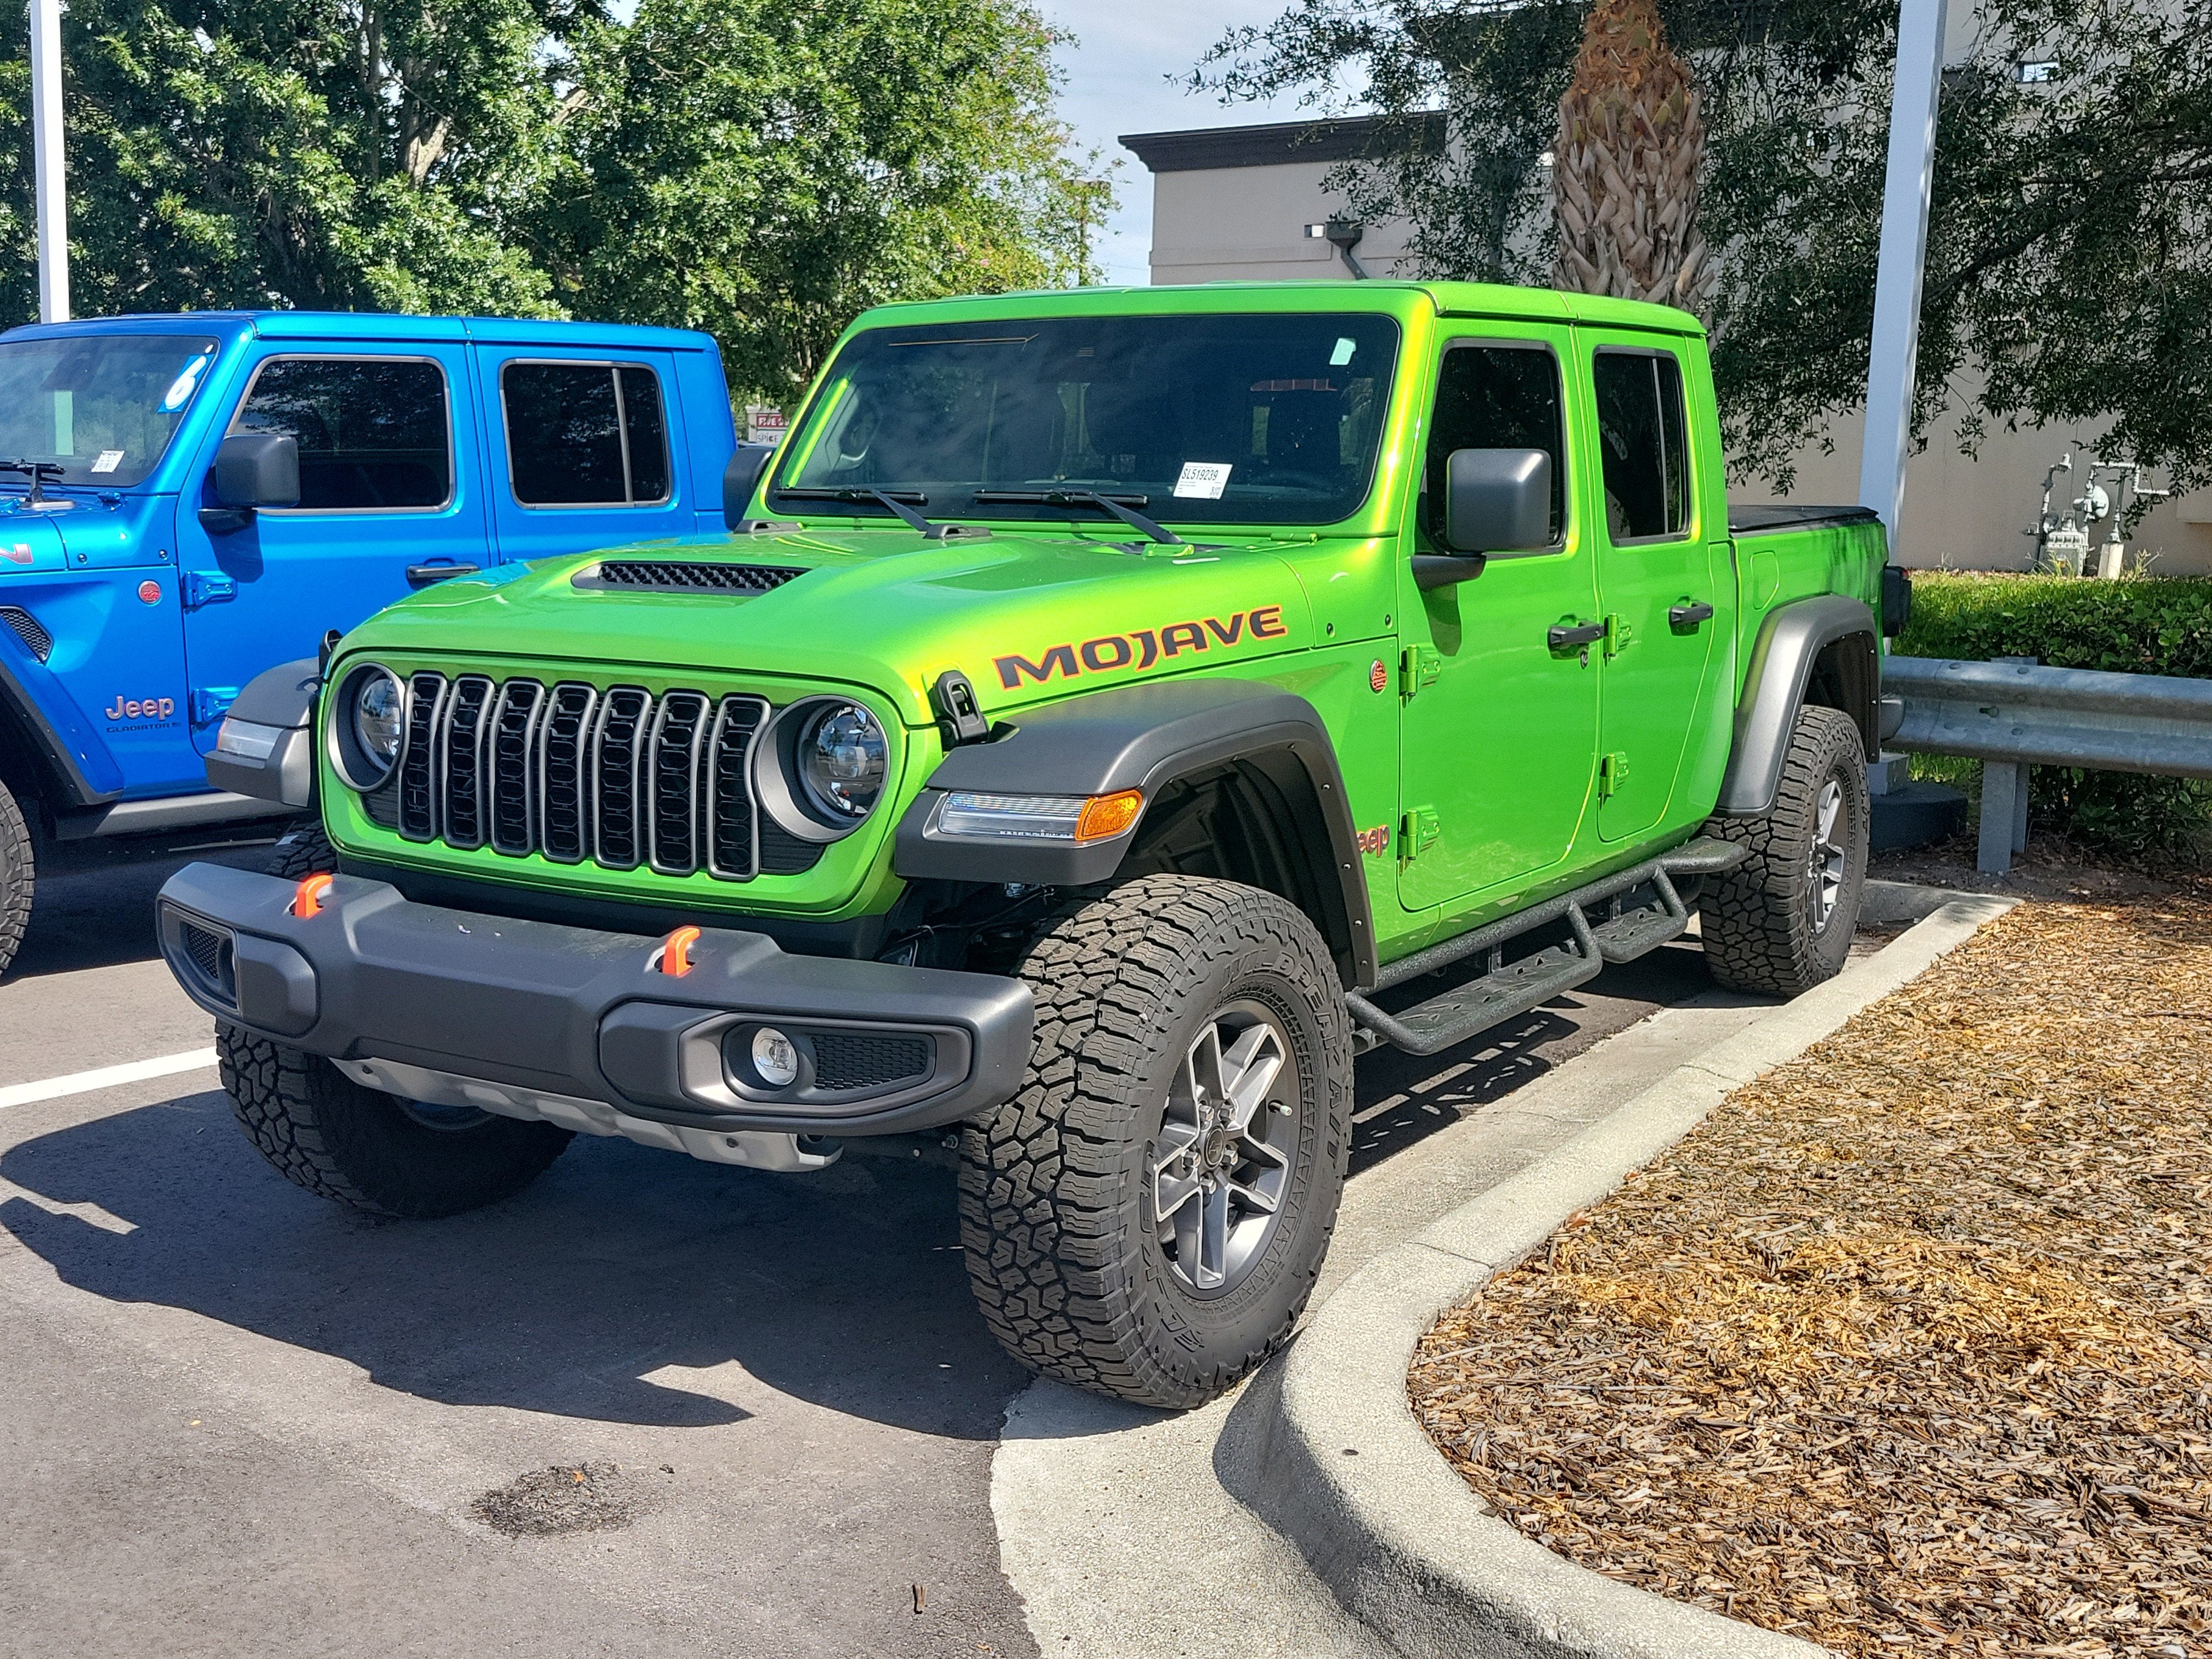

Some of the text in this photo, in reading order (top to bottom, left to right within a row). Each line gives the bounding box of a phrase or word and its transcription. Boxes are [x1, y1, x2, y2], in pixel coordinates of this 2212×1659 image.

[1182, 468, 1218, 481] SL519239
[992, 604, 1289, 692] MOJAVE
[105, 695, 174, 720] Jeep
[106, 722, 170, 733] GLADIATOR
[1356, 824, 1390, 858] eep
[1218, 948, 1340, 1068] WILDPEAK
